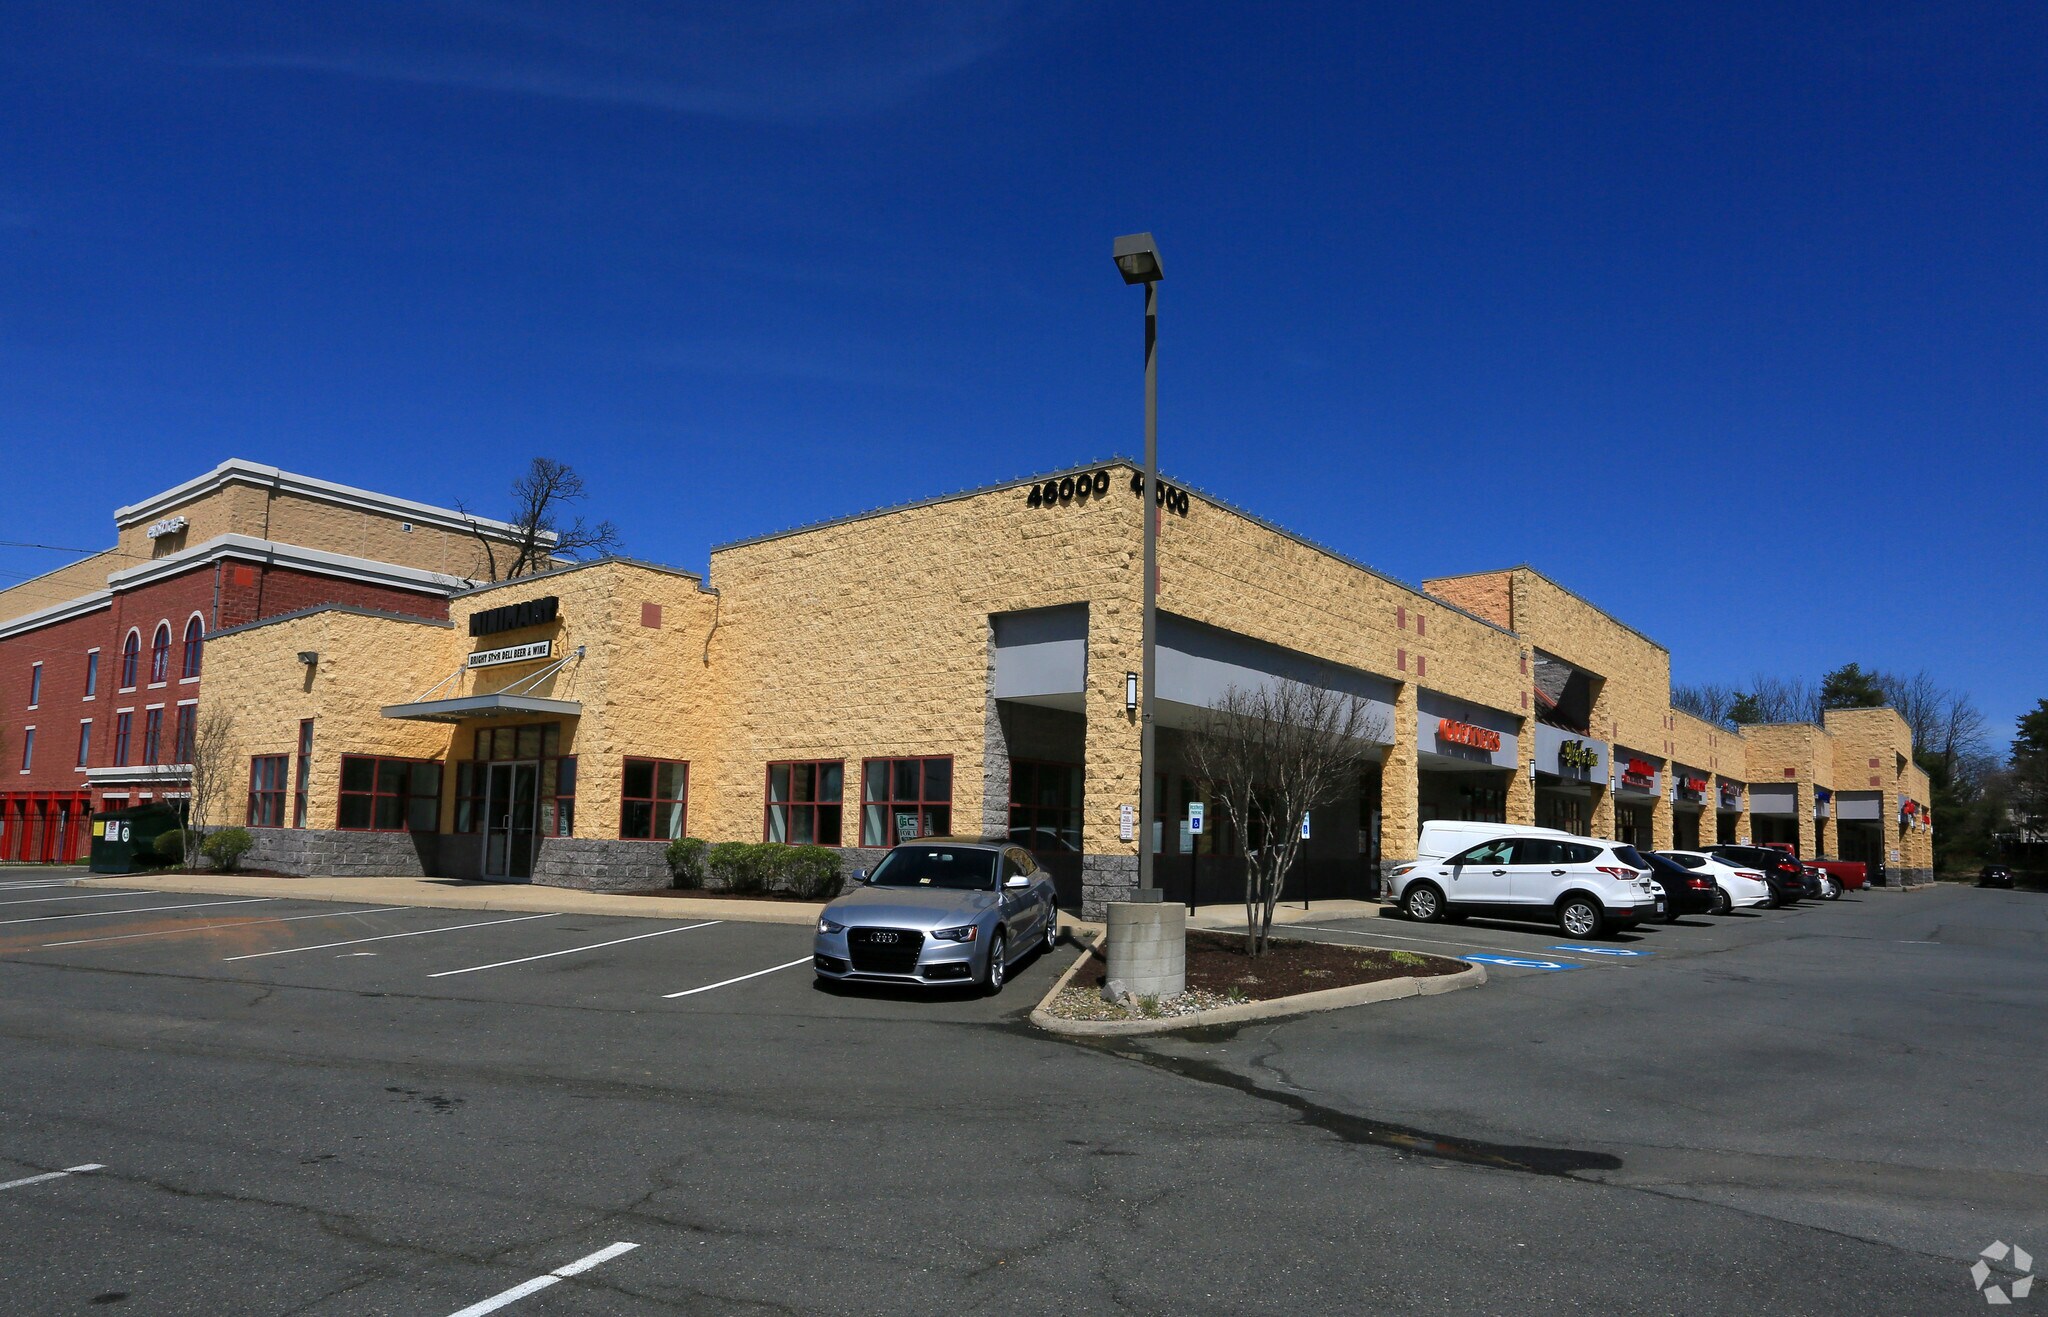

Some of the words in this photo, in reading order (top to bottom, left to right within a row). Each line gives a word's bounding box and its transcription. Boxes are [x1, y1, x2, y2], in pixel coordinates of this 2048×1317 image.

[1028, 470, 1110, 508] 46000
[1131, 472, 1189, 516] 4000
[470, 654, 487, 665] BRIGHT
[501, 649, 513, 660] DELI
[513, 647, 527, 658] BEER
[532, 645, 547, 655] WINE
